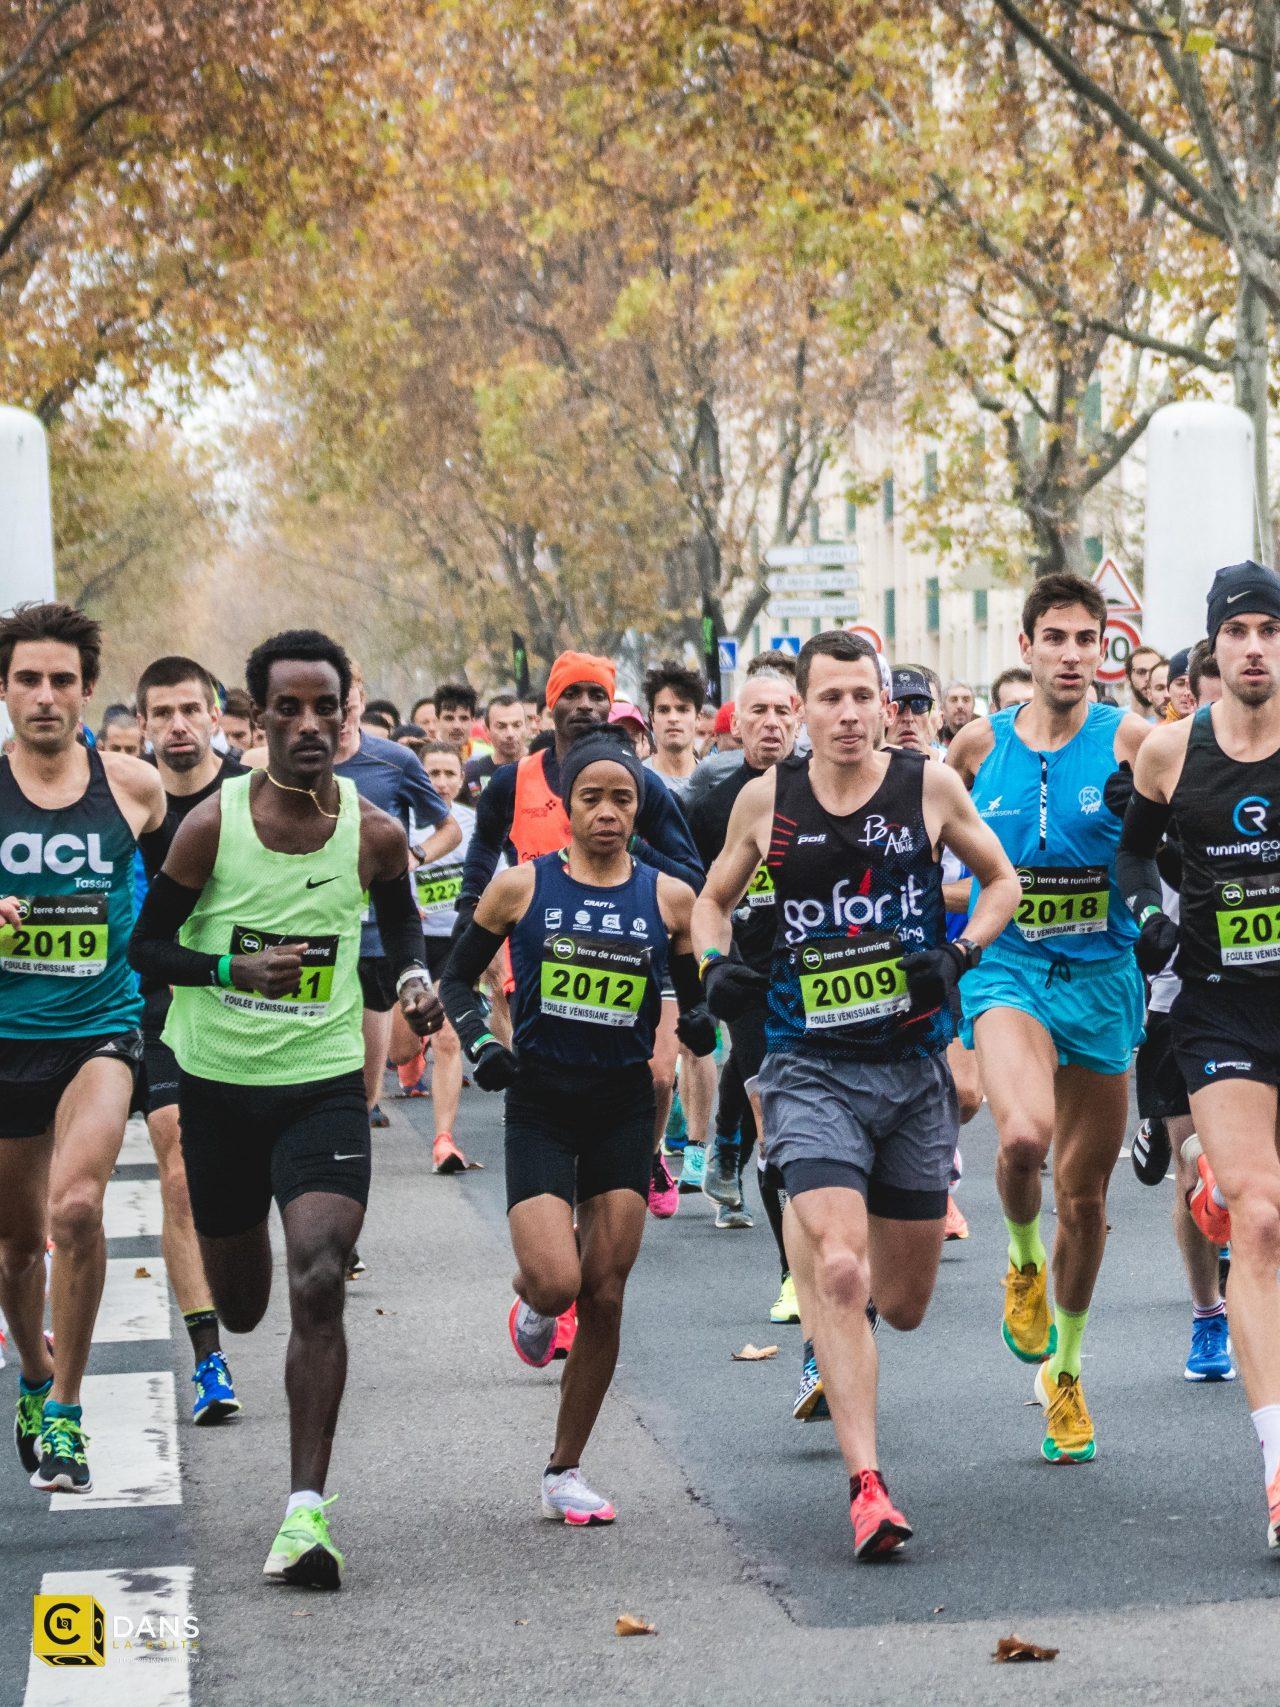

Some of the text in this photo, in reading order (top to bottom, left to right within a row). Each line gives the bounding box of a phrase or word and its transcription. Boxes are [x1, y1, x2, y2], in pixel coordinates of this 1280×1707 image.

[1105, 636, 1129, 661] 0
[74, 877, 112, 889] Tassin
[1037, 875, 1058, 884] terre
[1058, 875, 1069, 885] de
[1070, 875, 1101, 885] running
[1246, 886, 1267, 898] terre
[1268, 884, 1280, 894] de
[33, 905, 99, 915] terre de running
[784, 874, 924, 944] go for it
[1018, 896, 1098, 924] 2018
[12, 930, 96, 958] 2019
[823, 950, 843, 961] terre
[845, 947, 857, 957] de
[857, 941, 891, 954] running
[577, 946, 597, 958] terre
[598, 948, 609, 959] de
[610, 951, 642, 966] running
[550, 969, 634, 1008] 2012
[812, 966, 897, 1008] 2009
